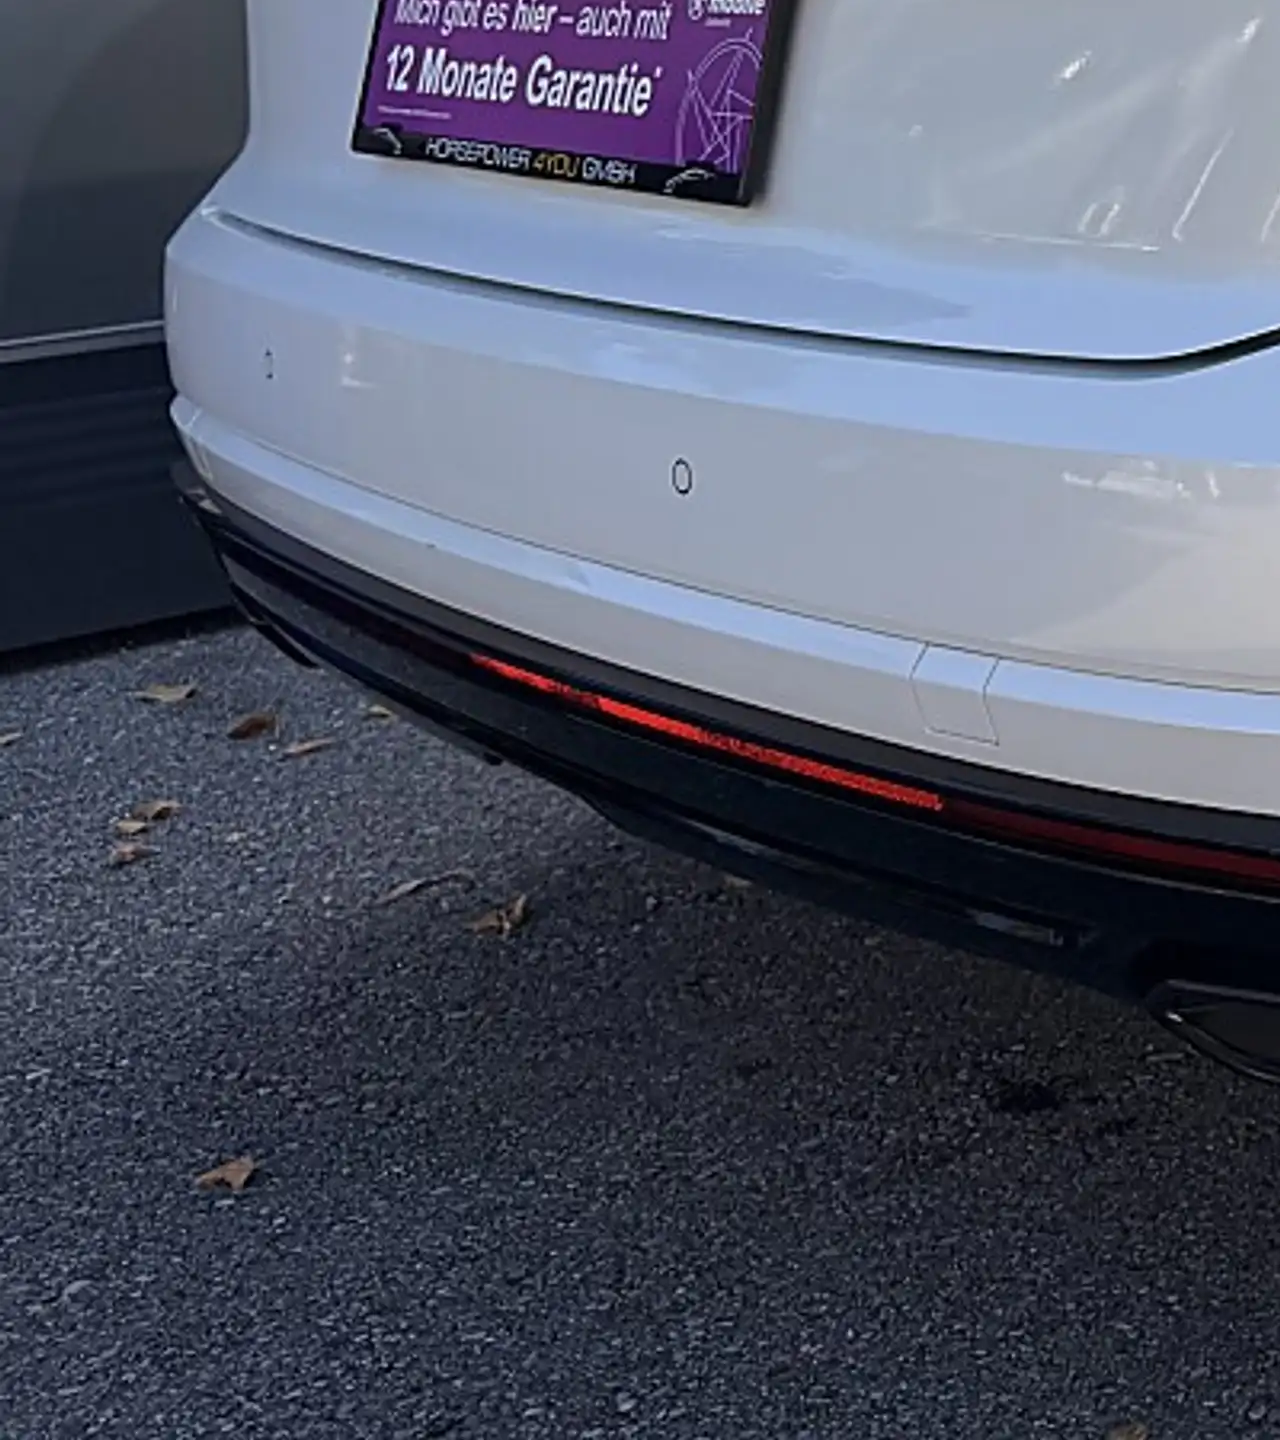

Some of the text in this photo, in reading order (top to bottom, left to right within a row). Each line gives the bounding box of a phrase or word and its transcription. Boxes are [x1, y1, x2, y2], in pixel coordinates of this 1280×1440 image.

[482, 0, 509, 32] es
[575, 0, 631, 38] auch
[633, 0, 673, 40] mit
[386, 44, 415, 92] 12
[416, 47, 518, 104] Monate
[425, 136, 533, 172] HORSEPOWER
[532, 152, 581, 178] 4YOU
